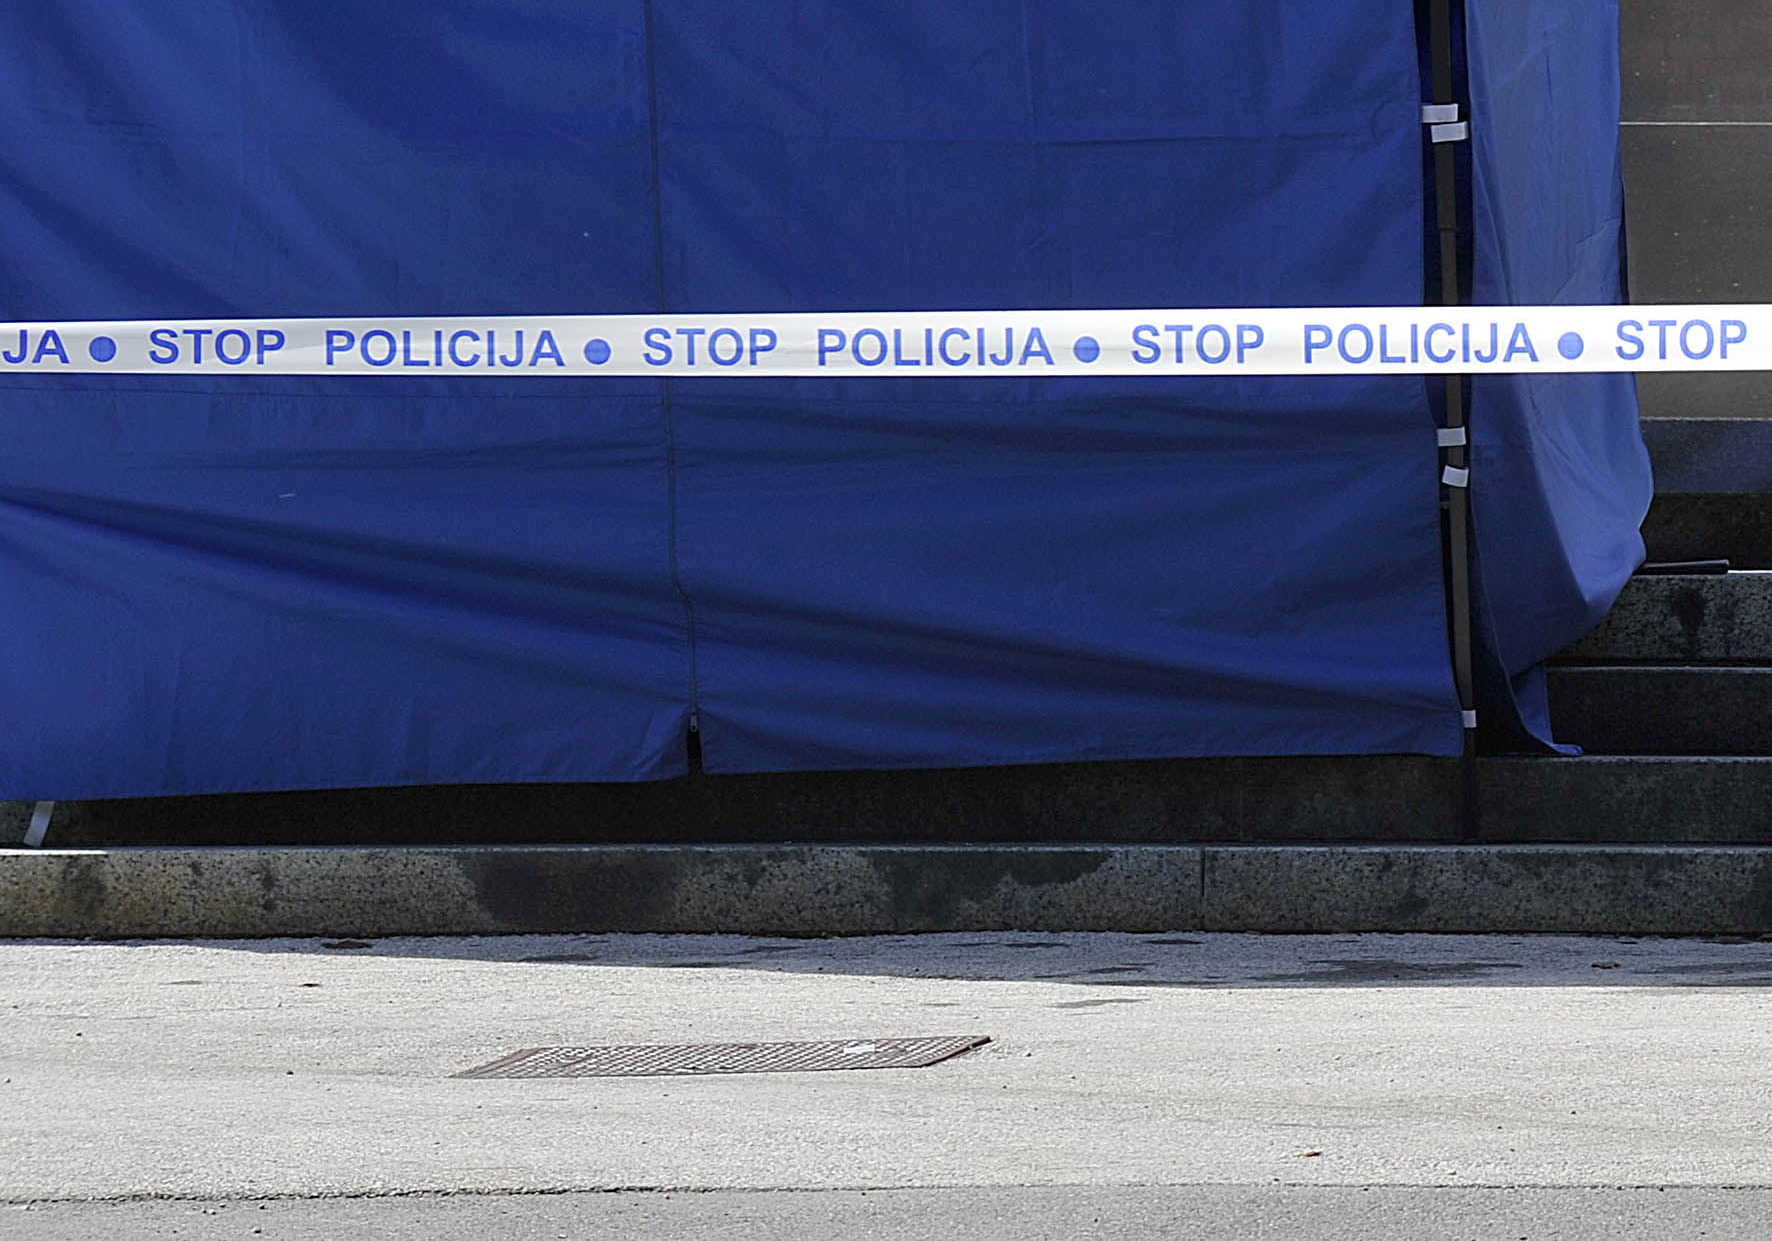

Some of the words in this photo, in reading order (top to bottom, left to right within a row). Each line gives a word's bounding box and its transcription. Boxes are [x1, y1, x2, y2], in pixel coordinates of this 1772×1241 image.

[149, 328, 286, 366] STOP
[326, 329, 566, 368] POLICIJA
[644, 328, 778, 366] STOP
[818, 327, 1055, 367] POLICIJA
[1132, 324, 1265, 365] STOP
[1303, 322, 1539, 364] POLICIJA
[1616, 319, 1747, 361] STOP
